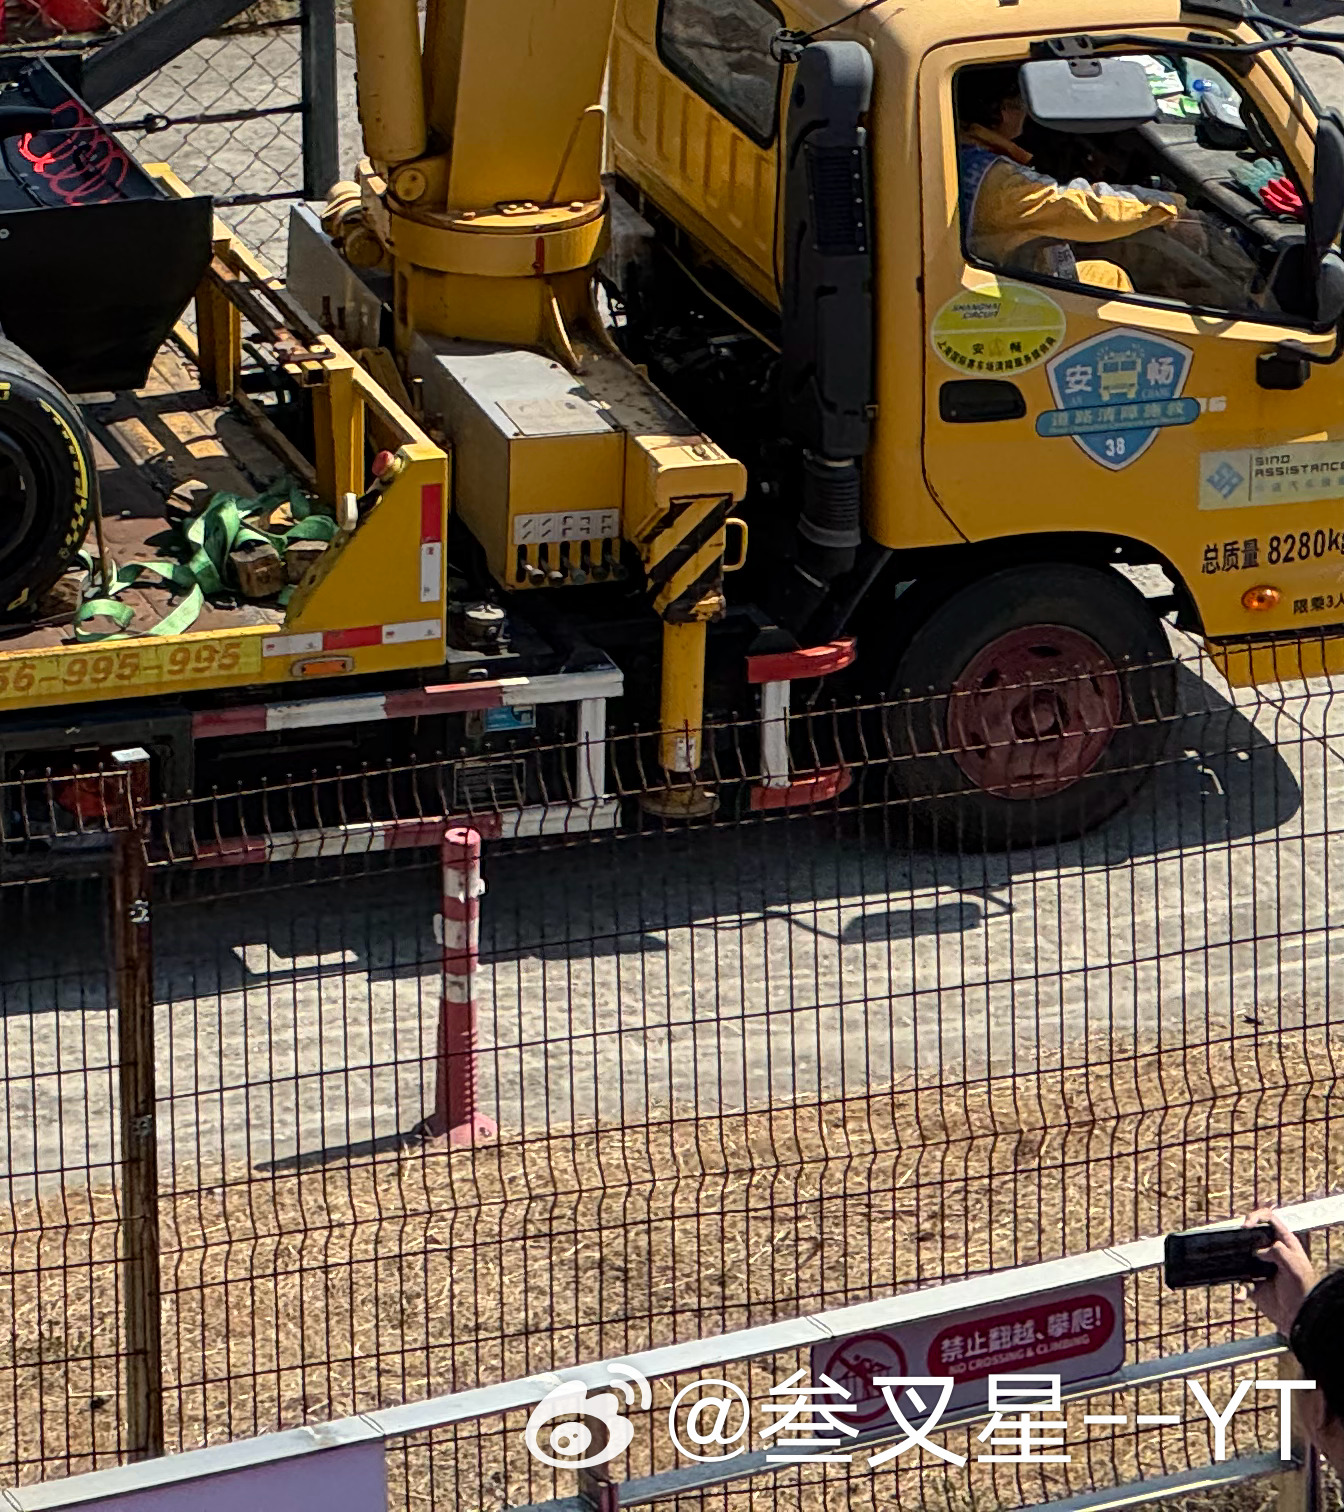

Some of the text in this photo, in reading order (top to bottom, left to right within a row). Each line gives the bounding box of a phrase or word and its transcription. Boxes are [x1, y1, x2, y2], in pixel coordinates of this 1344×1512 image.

[1105, 437, 1126, 458] 38
[1202, 538, 1260, 575] 总质量
[950, 1364, 967, 1375] NO
[969, 1349, 1023, 1372] CROSSING
[1038, 1334, 1090, 1355] CLIMBING
